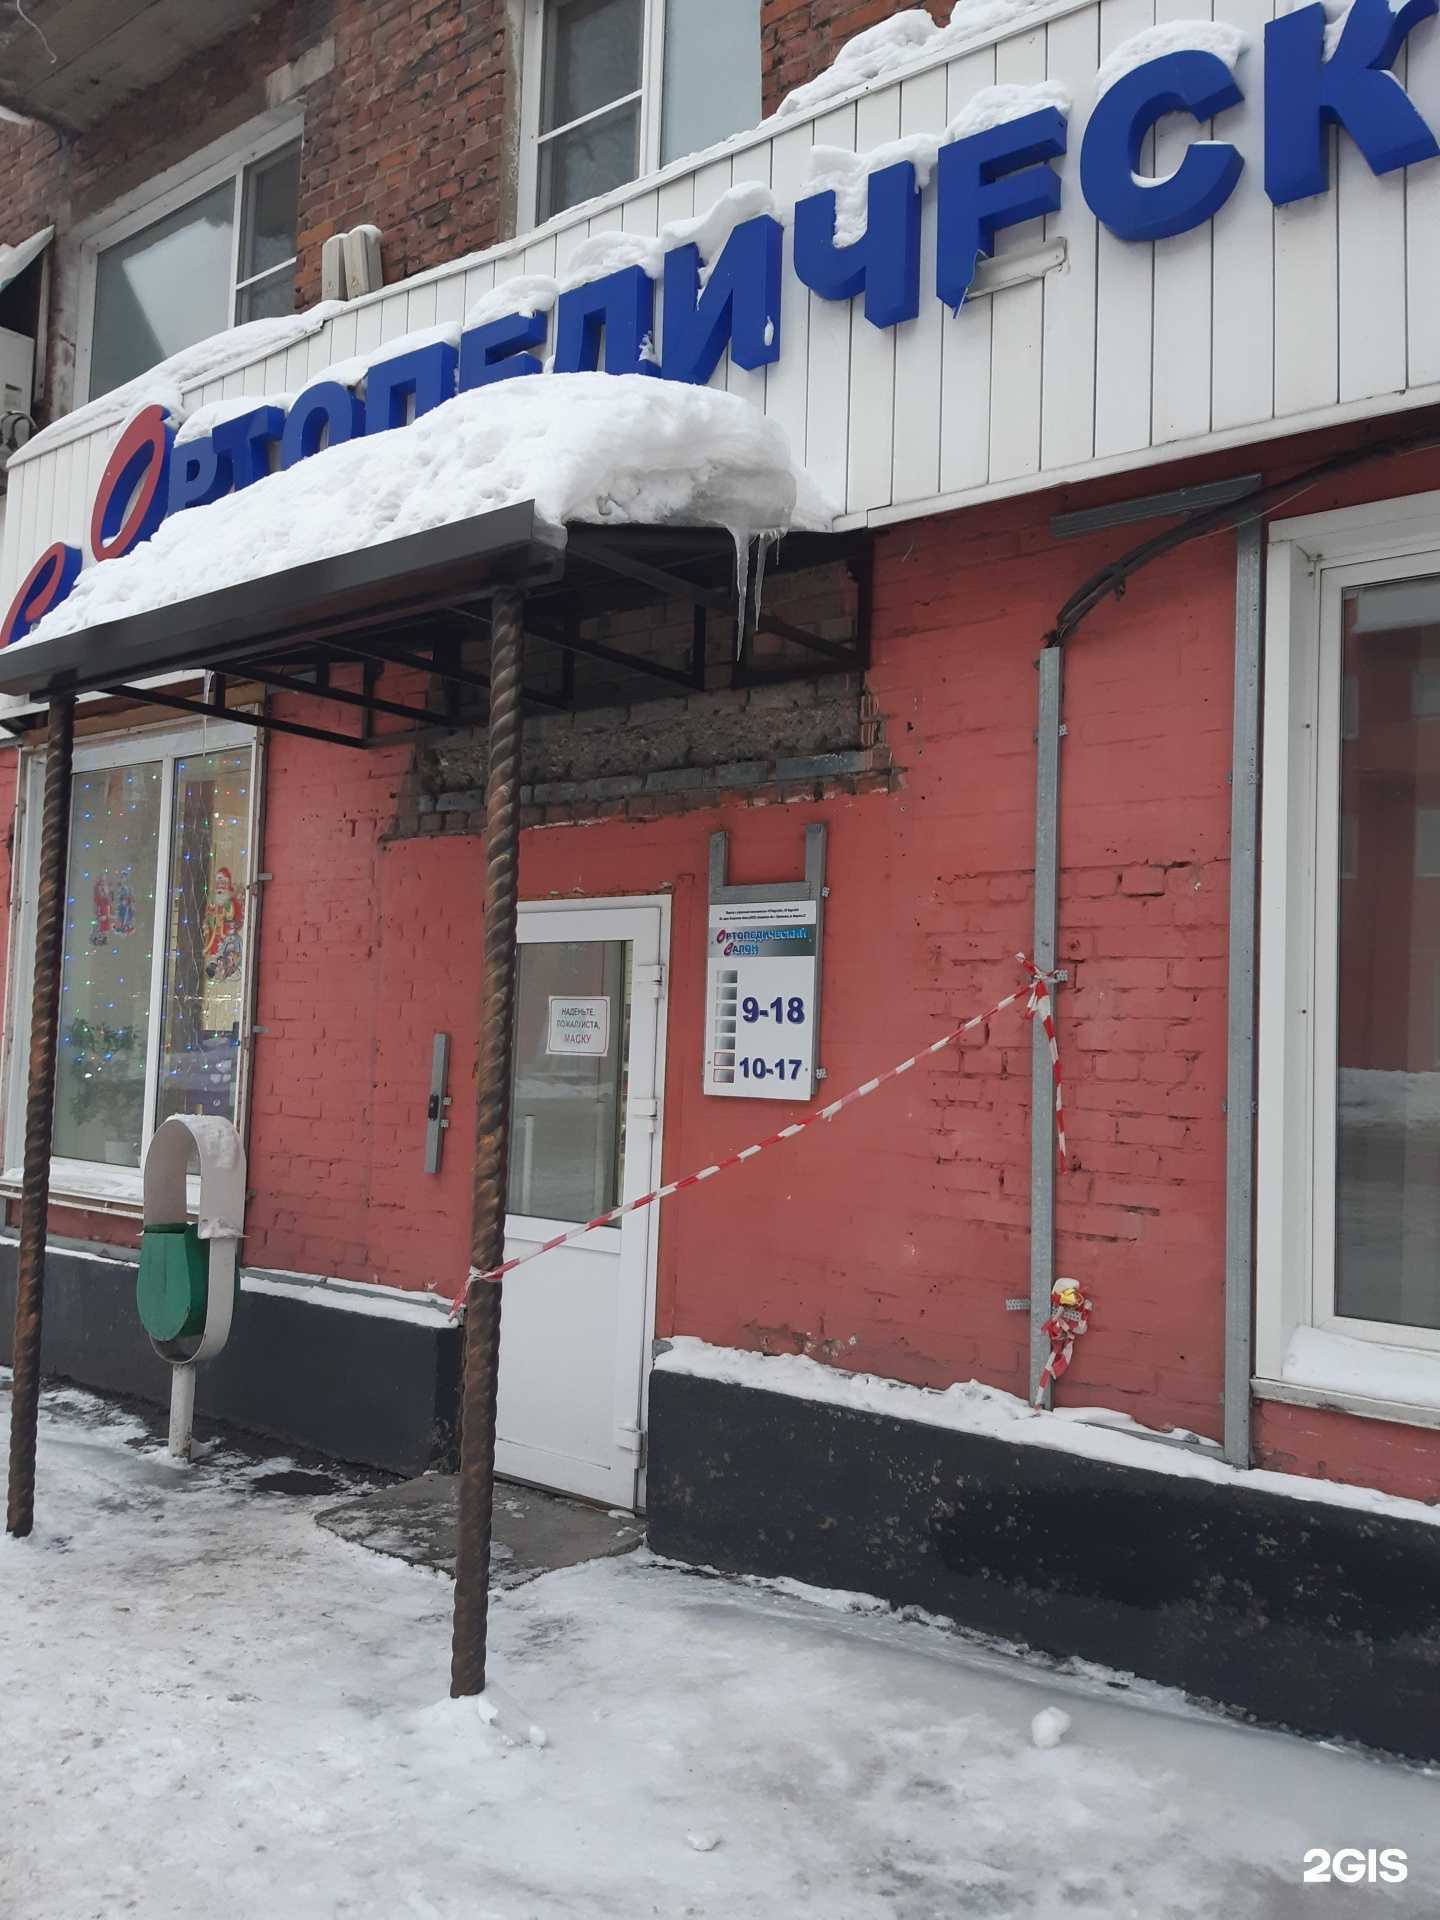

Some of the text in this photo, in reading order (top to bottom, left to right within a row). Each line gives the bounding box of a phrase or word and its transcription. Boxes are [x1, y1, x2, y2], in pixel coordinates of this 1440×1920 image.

[717, 927, 807, 944] ОРТОПЕДИЧЕСКИЙ
[724, 942, 759, 956] САЛОН
[742, 996, 806, 1024] 9-18
[564, 1033, 592, 1044] МАСКУ
[739, 1057, 803, 1081] 10-17
